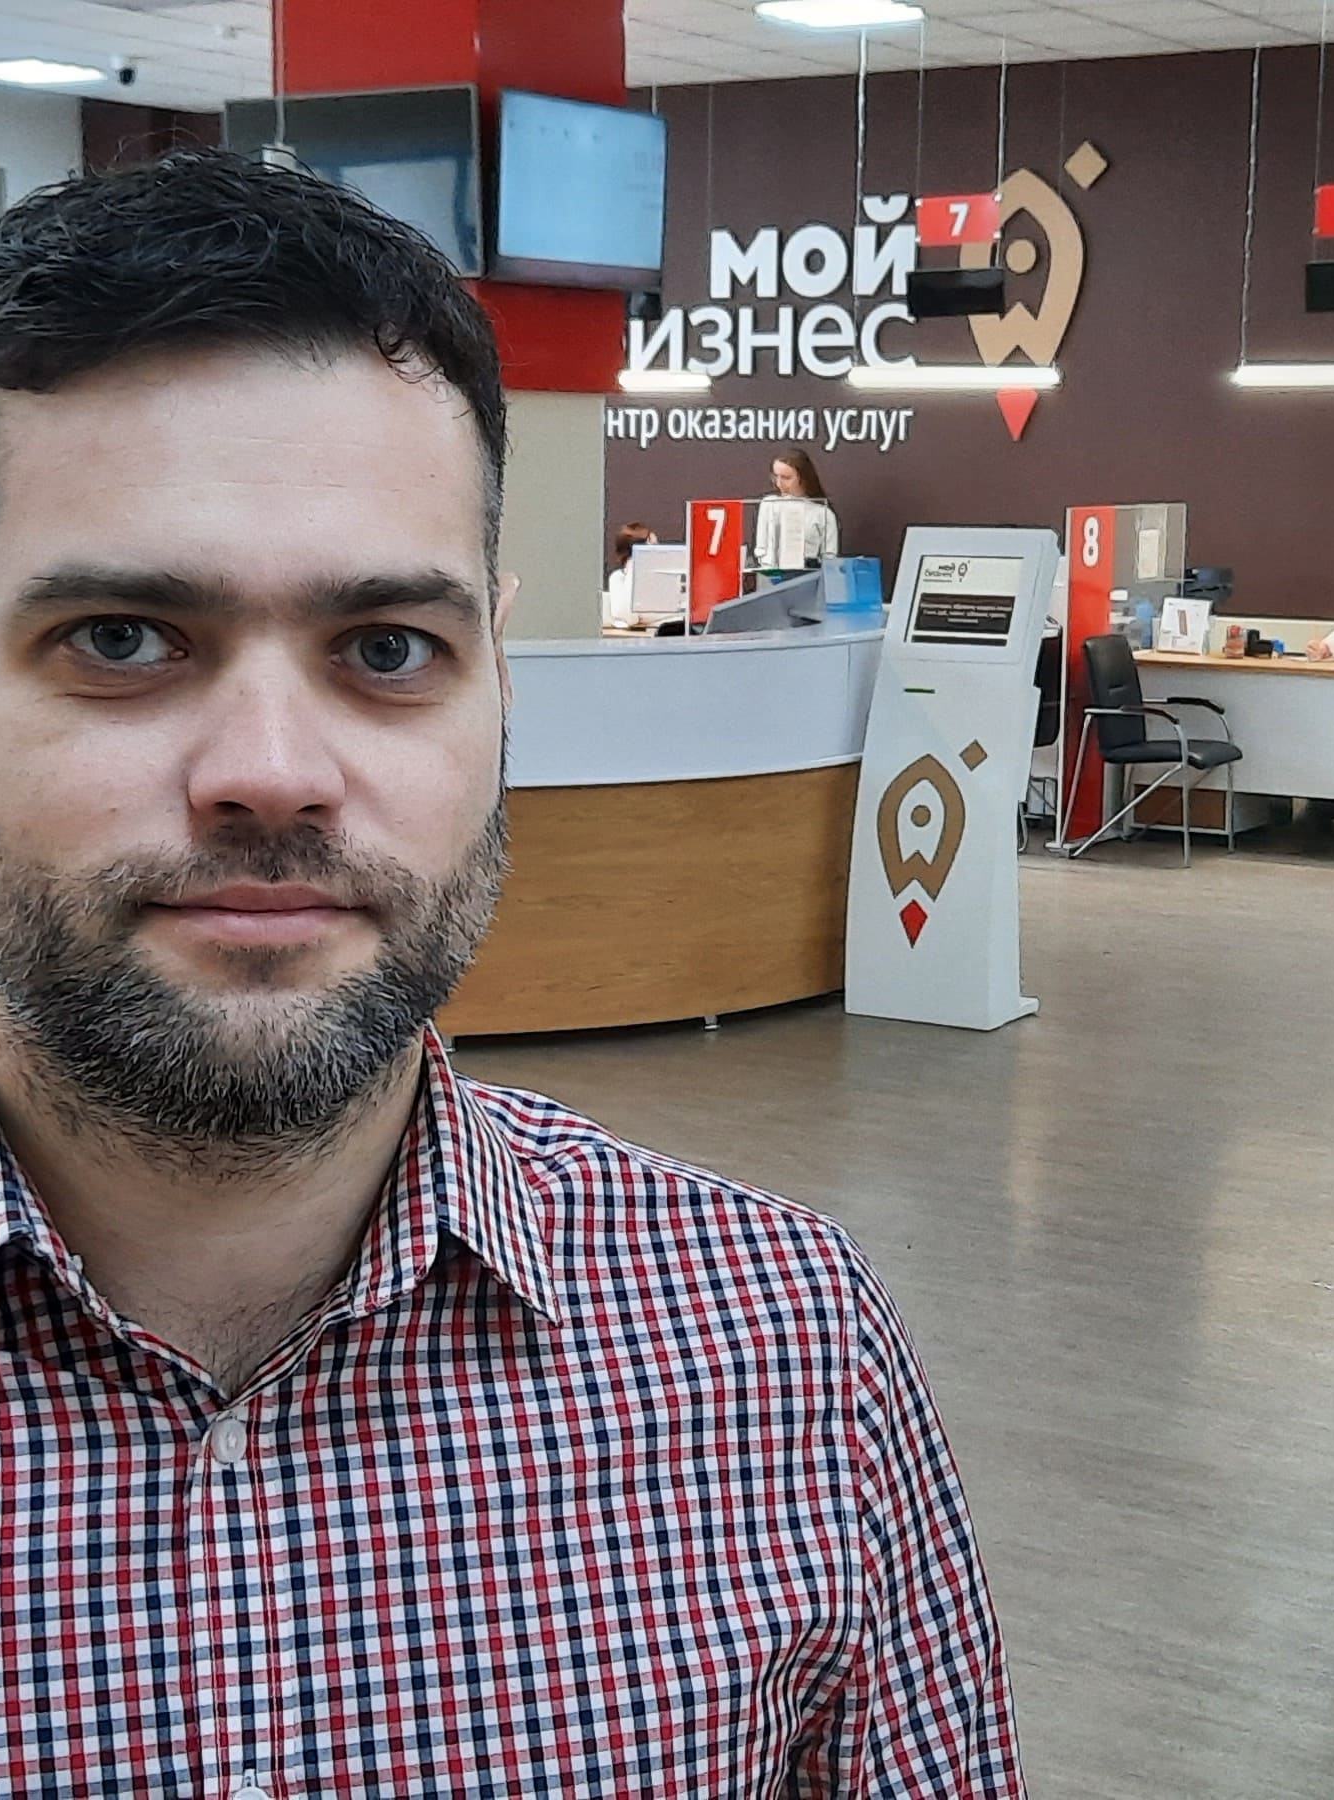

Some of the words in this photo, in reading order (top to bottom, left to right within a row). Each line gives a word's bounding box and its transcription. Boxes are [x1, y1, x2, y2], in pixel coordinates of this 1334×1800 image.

[948, 204, 968, 236] 7
[710, 193, 916, 298] мой
[623, 303, 916, 377] изнес
[605, 408, 660, 448] нтр
[668, 408, 815, 440] оказания
[823, 408, 914, 451] услуг
[706, 508, 726, 556] 7
[1082, 517, 1100, 567] 8
